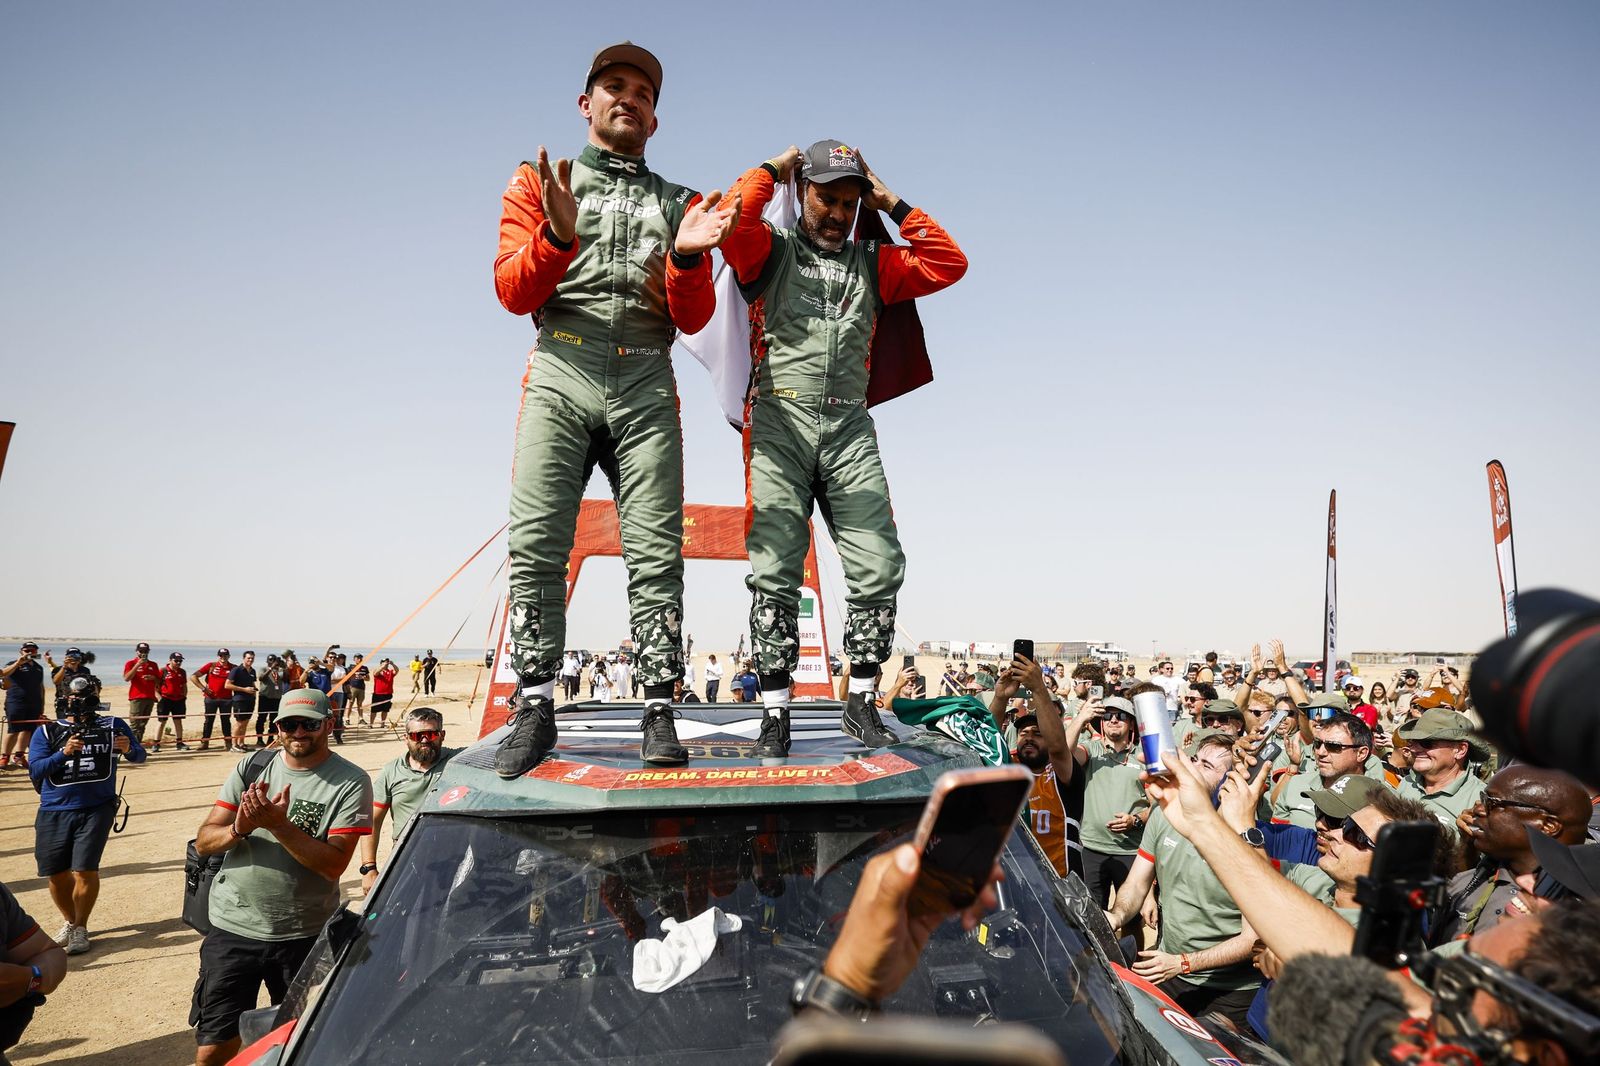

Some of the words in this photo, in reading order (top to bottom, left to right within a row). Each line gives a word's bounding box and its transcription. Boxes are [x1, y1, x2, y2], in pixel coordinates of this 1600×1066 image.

[829, 157, 846, 167] Red
[556, 331, 579, 345] Sabelt
[93, 743, 109, 754] TV
[64, 757, 95, 774] 15
[625, 770, 700, 782] DREAM.
[705, 769, 762, 780] DARE.
[768, 769, 806, 779] LIVE
[811, 768, 834, 778] IT.
